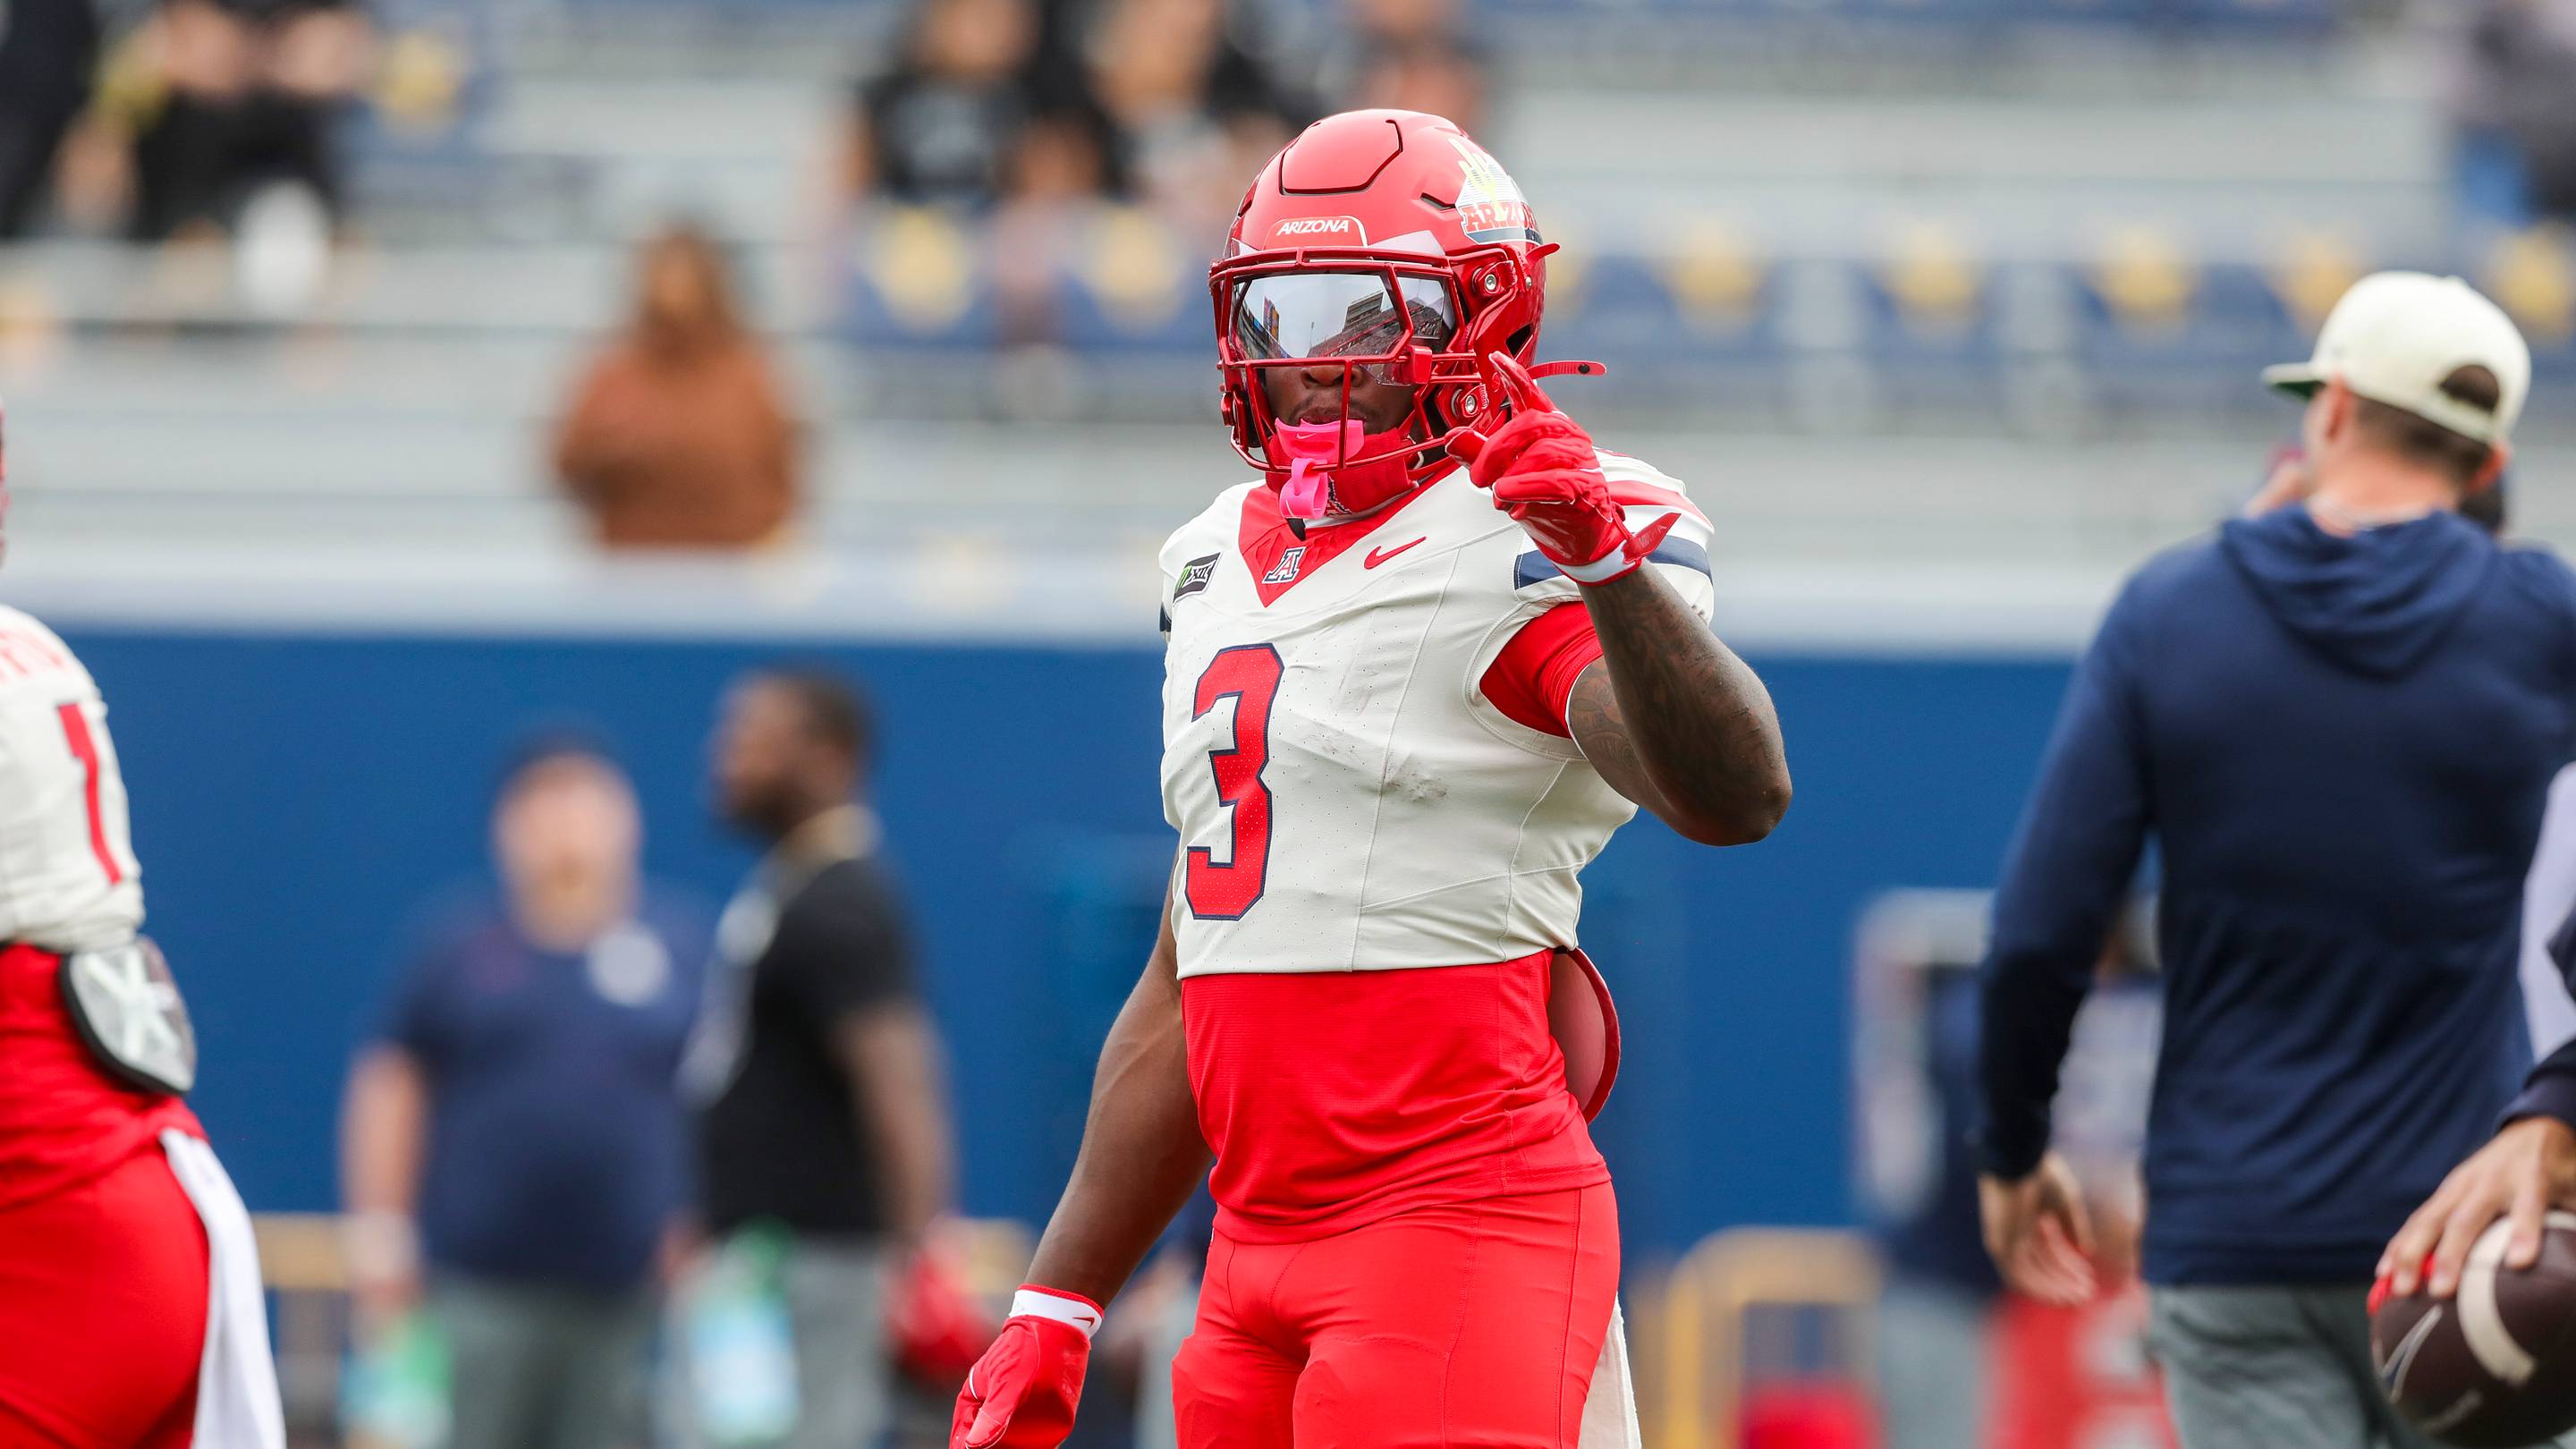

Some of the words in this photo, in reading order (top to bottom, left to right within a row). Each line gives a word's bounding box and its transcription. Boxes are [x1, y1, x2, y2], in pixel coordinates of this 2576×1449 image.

[1275, 219, 1350, 236] ARIZONA
[1262, 547, 1307, 583] A
[1184, 642, 1285, 921] 3
